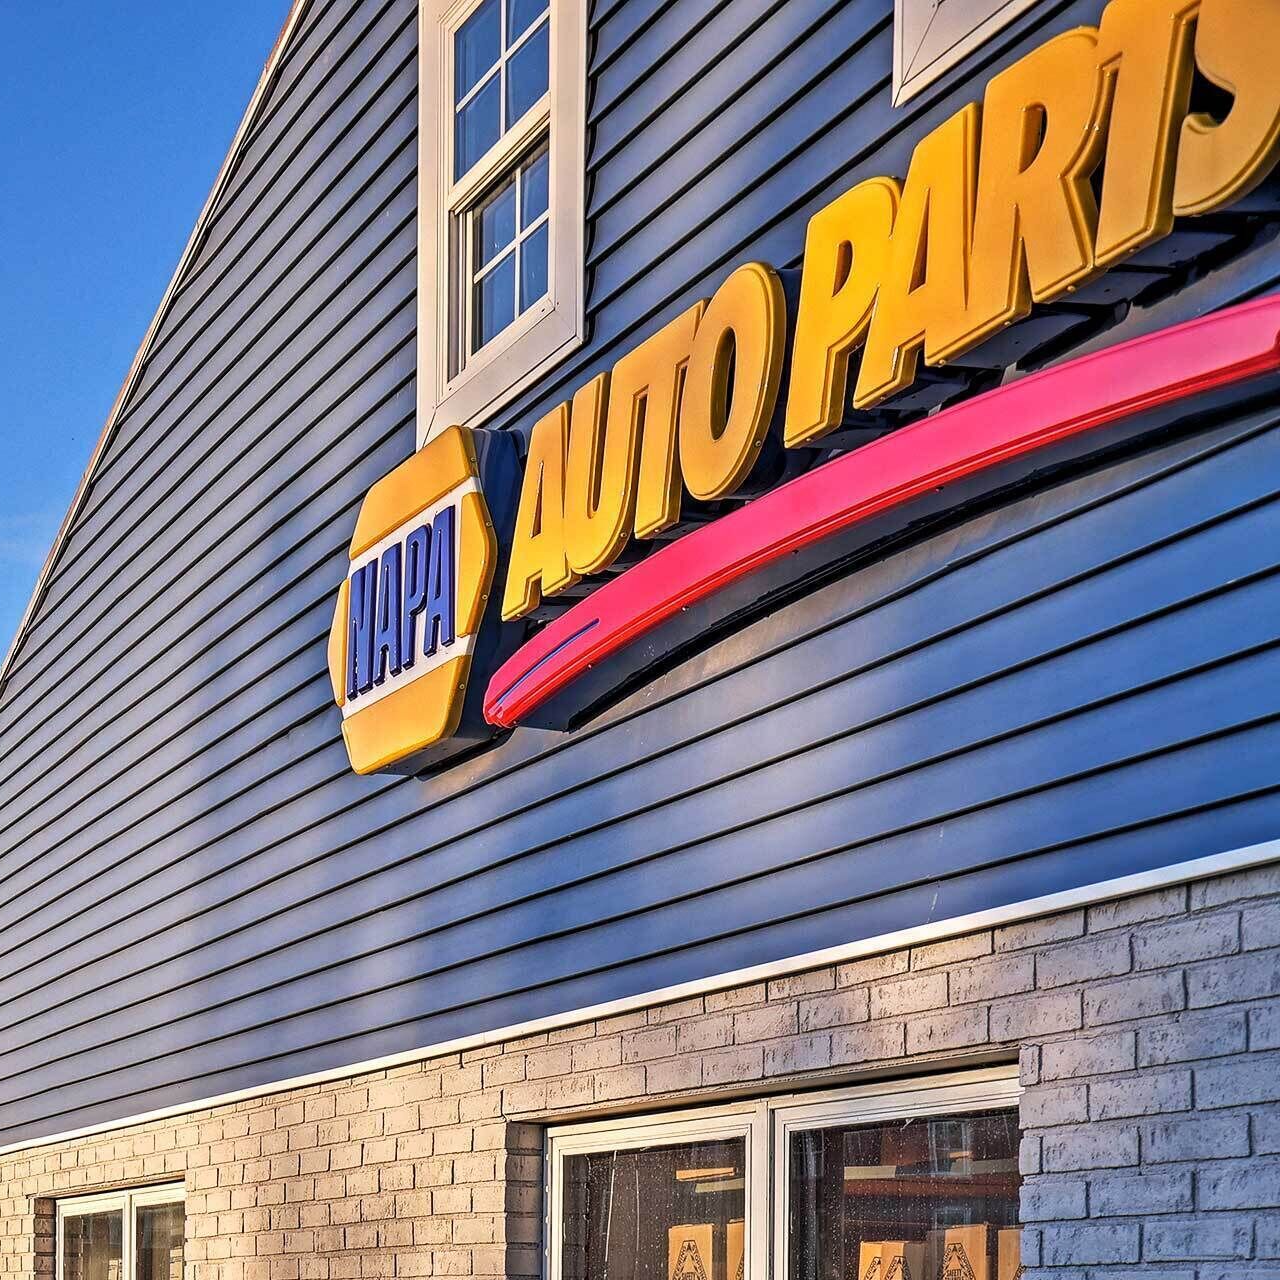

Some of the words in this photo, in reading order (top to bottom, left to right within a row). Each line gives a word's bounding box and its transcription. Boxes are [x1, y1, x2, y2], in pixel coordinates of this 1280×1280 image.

[346, 504, 457, 702] NAPA
[500, 262, 785, 624] AUTO
[784, 0, 1280, 450] PARTS
